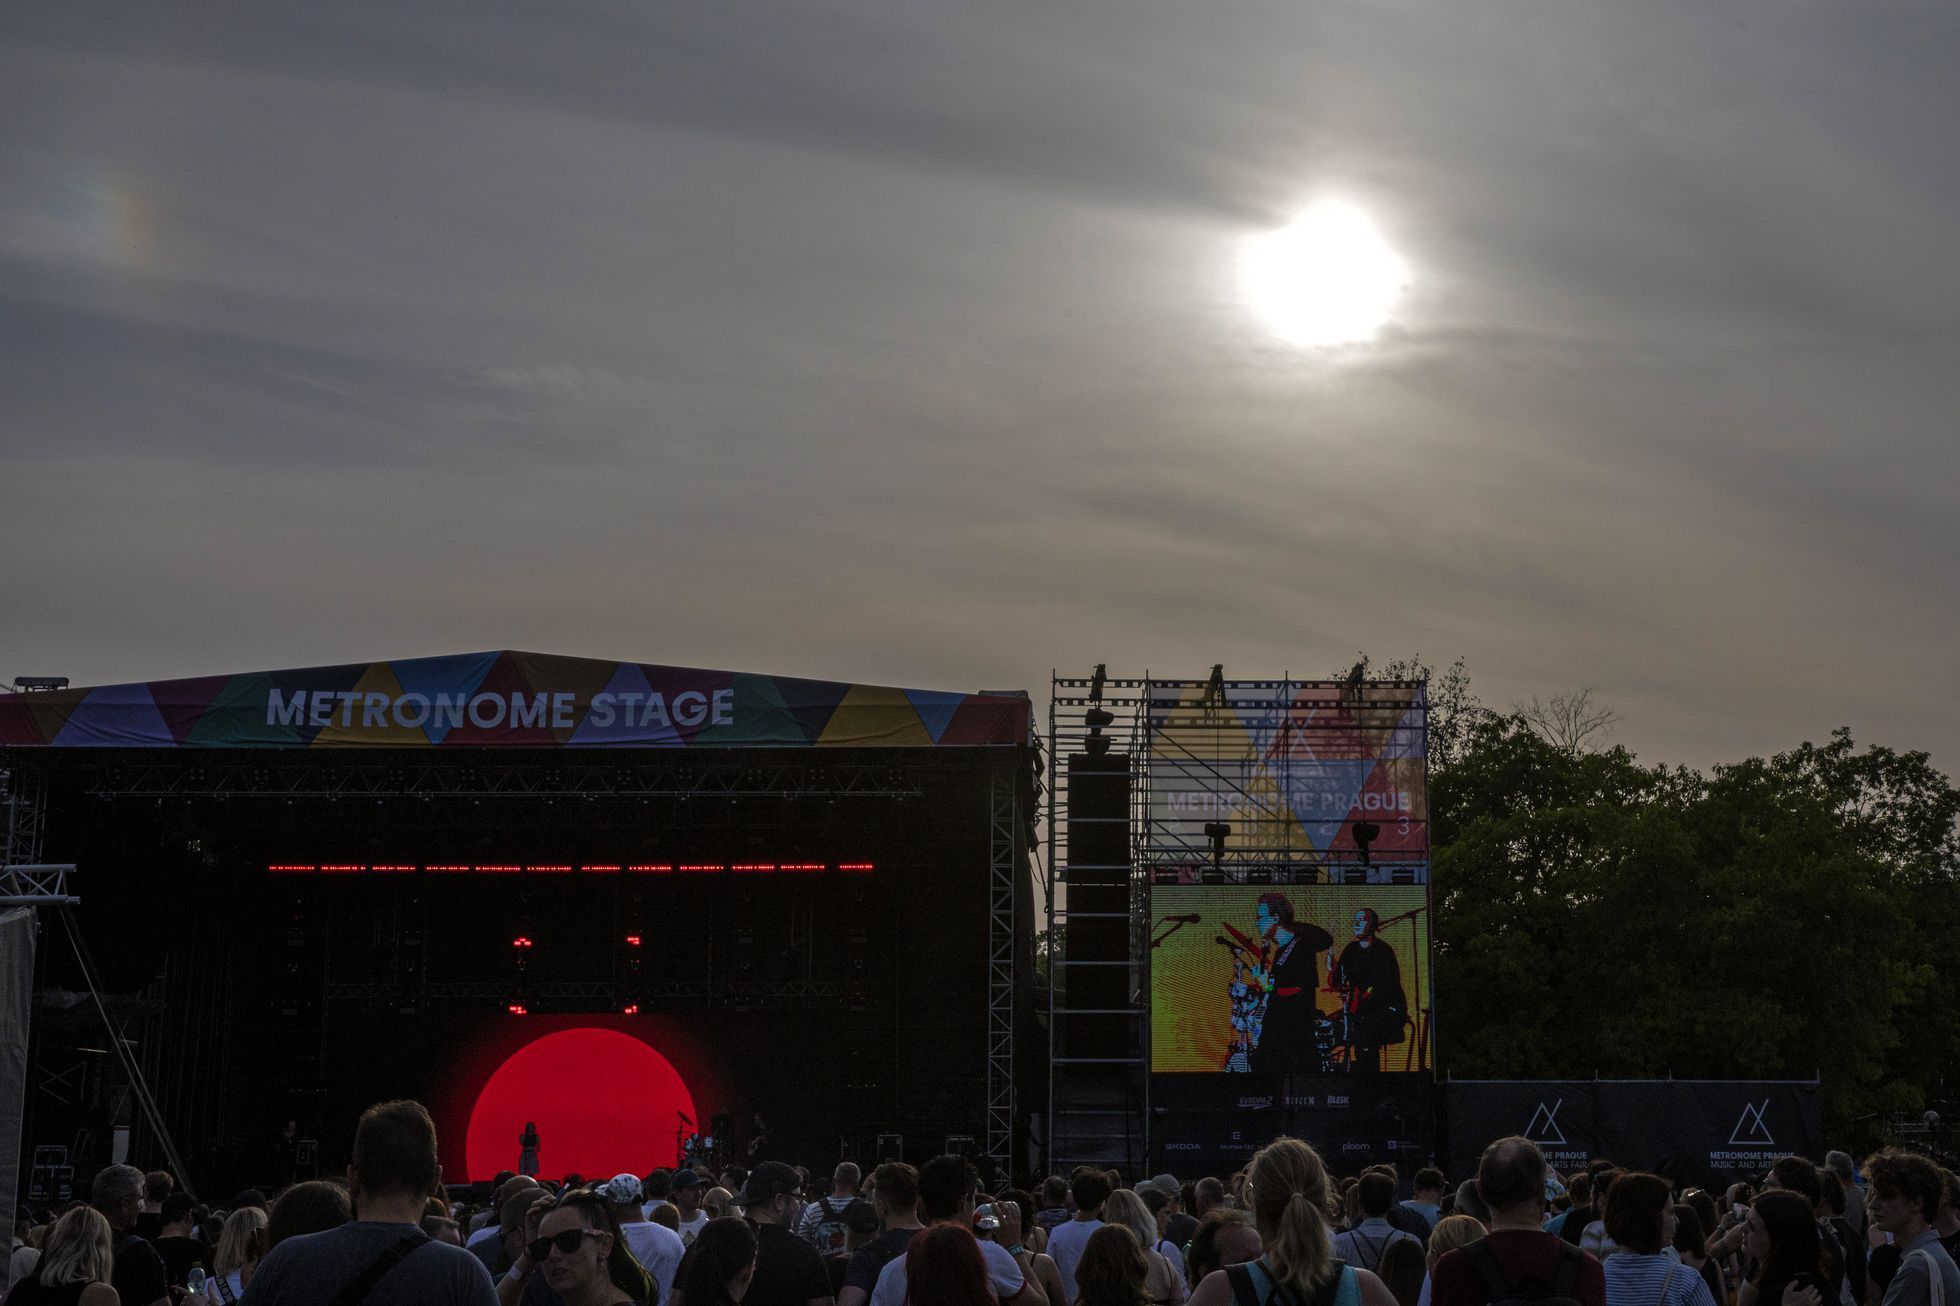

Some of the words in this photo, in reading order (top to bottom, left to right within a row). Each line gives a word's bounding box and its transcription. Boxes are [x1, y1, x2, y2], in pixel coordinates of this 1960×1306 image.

[266, 688, 575, 728] METRONOME
[590, 688, 734, 728] STAGE
[1320, 791, 1413, 811] PRAGUE
[1397, 817, 1410, 835] 3
[1327, 1095, 1350, 1105] BLESK
[1342, 1140, 1370, 1153] ploom
[1555, 1151, 1588, 1160] PRAGUE
[1710, 1151, 1761, 1160] METRONOME
[1763, 1151, 1795, 1160] PRAGUE
[1551, 1160, 1569, 1169] ARTS
[1570, 1160, 1588, 1169] FAIR
[1710, 1160, 1735, 1169] MUSIC
[1737, 1160, 1756, 1169] AND
